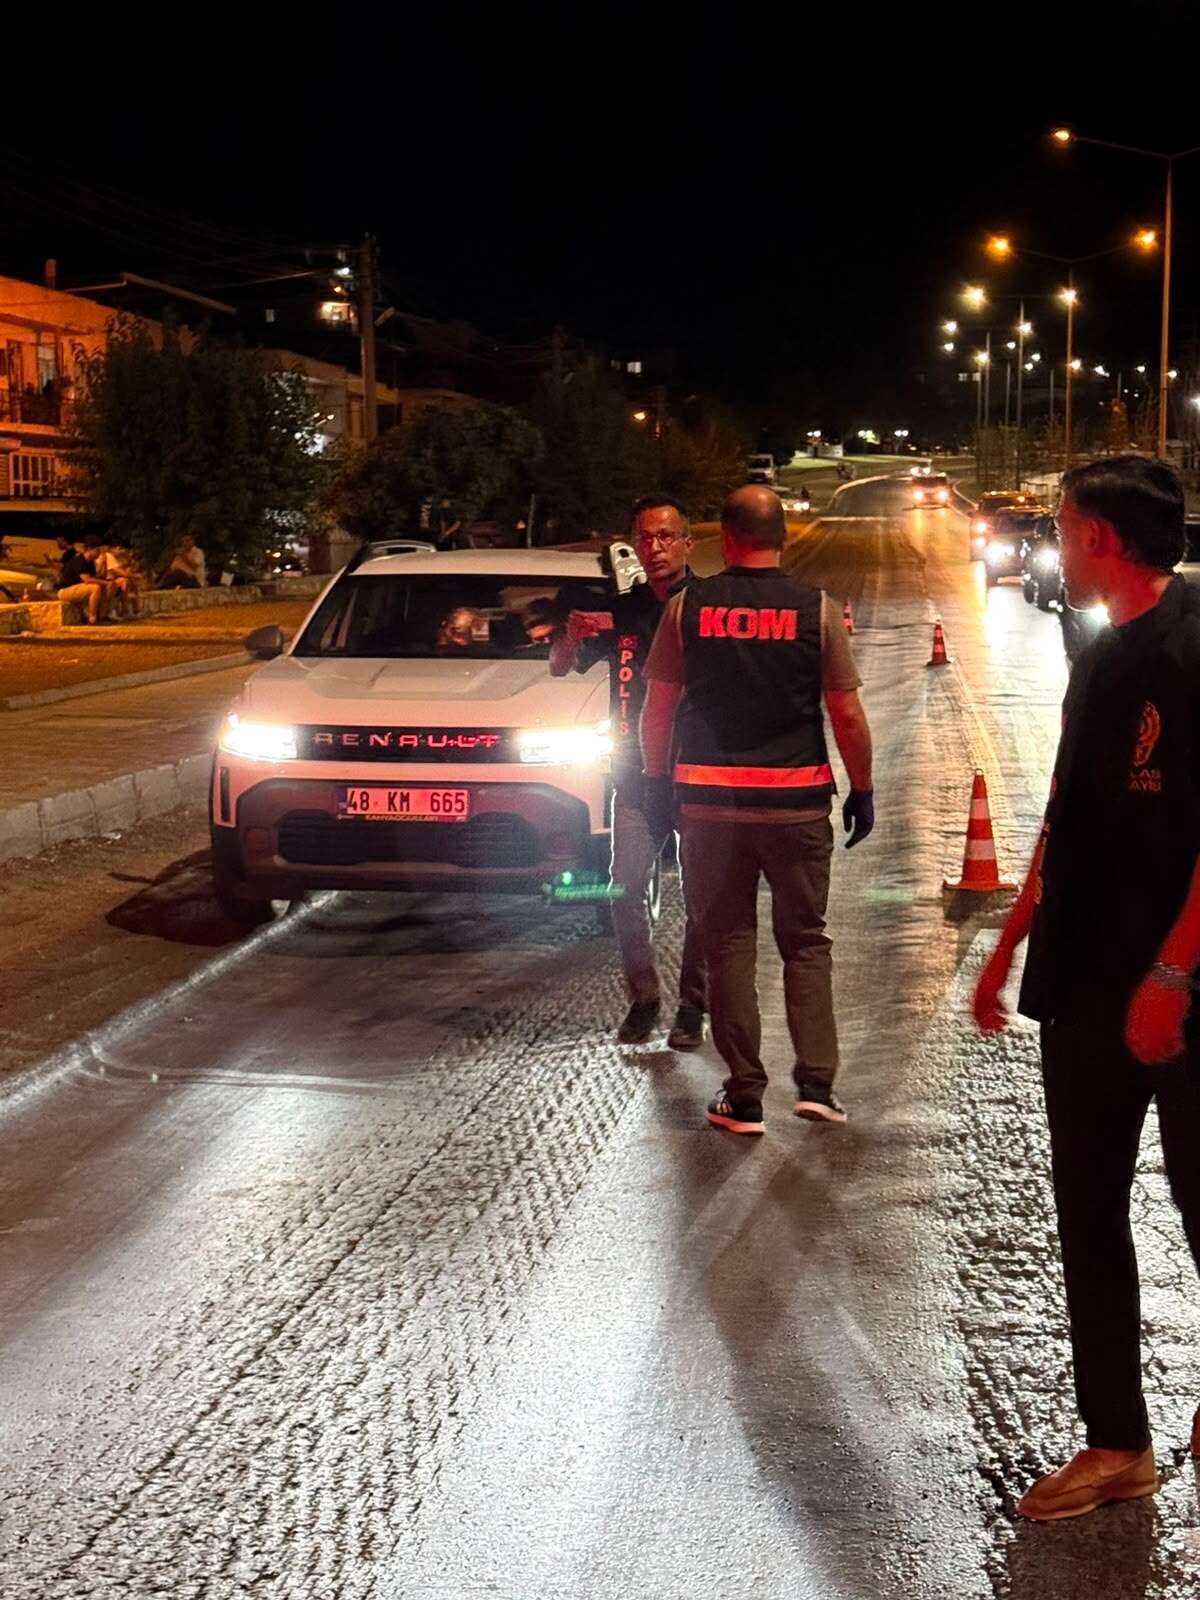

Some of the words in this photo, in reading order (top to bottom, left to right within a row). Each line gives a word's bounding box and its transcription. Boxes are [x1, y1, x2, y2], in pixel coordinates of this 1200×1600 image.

[699, 606, 798, 640] KOM
[313, 732, 500, 748] RENAULT
[348, 790, 370, 811] 48
[388, 791, 410, 812] KM
[430, 792, 466, 813] 665
